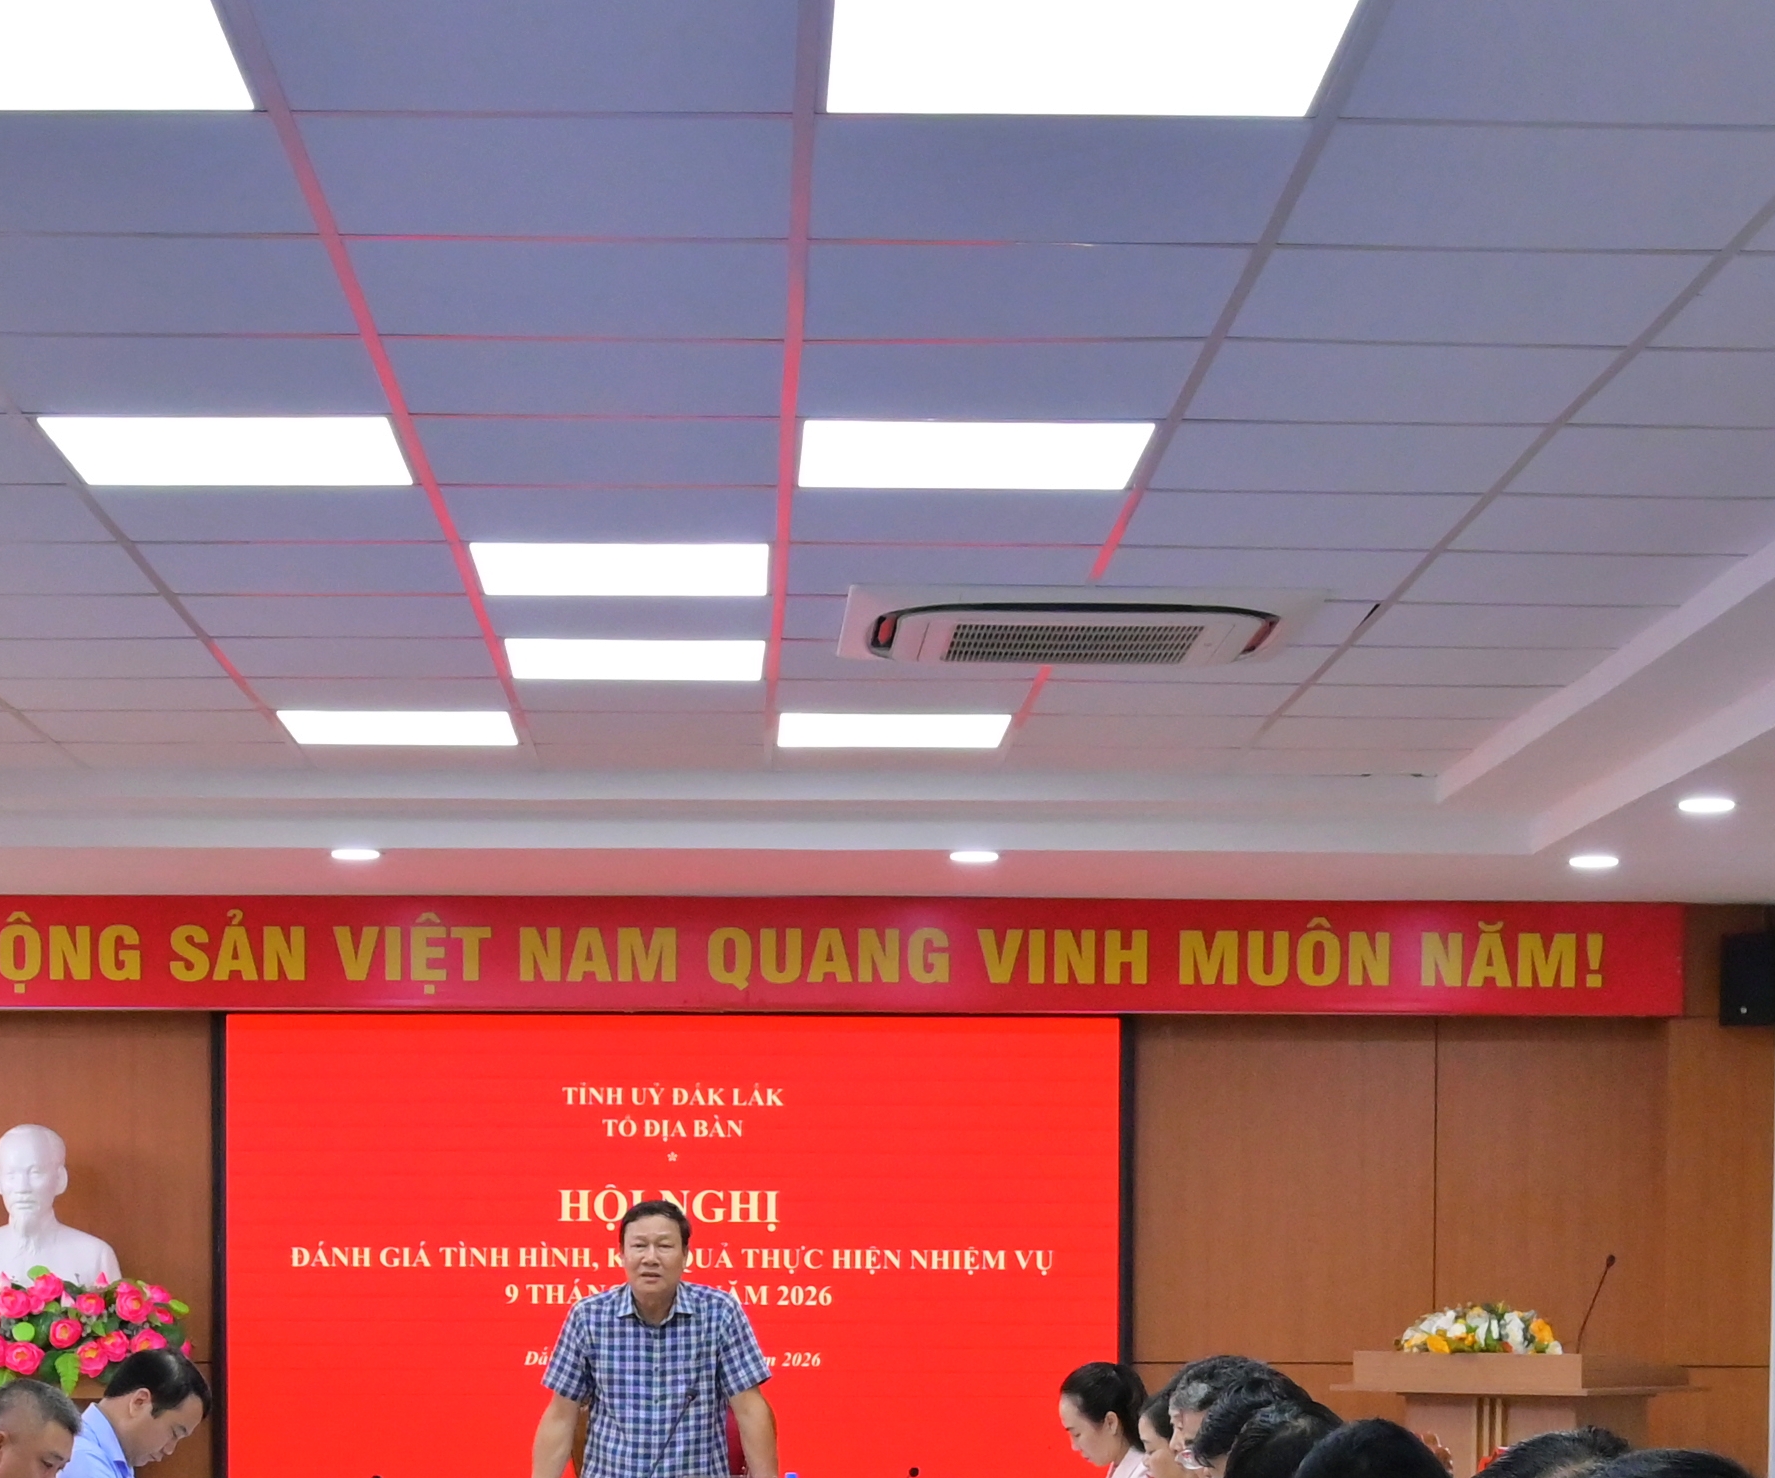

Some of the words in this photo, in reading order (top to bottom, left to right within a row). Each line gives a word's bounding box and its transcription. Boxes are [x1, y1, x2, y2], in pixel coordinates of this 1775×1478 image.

[169, 909, 306, 982] SẢN
[332, 911, 492, 995] VIỆT
[519, 926, 678, 983] NAM
[707, 927, 951, 991] QUANG
[977, 928, 1148, 985] VINH
[1179, 916, 1391, 987] MUÔN
[1421, 920, 1605, 989] NĂM!
[562, 1082, 624, 1105] TỈNH
[631, 1082, 664, 1105] UỶ
[672, 1083, 725, 1106] ĐẮK
[732, 1083, 784, 1106] LẮK
[602, 1115, 637, 1138] TỔ
[643, 1119, 687, 1142] ĐỊA
[693, 1115, 743, 1138] BÀN
[291, 1241, 371, 1268] ĐÁNH
[379, 1241, 431, 1268] GIÁ
[439, 1241, 509, 1268] TÌNH
[519, 1241, 599, 1272] HÌNH,
[741, 1245, 823, 1275] THỰC
[832, 1246, 901, 1276] HIỆN
[910, 1246, 1007, 1276] NHIỆM
[1014, 1249, 1054, 1276] VỤ
[505, 1284, 520, 1304] 9
[717, 1280, 770, 1306] ĂM
[777, 1286, 832, 1306] 2026
[781, 1351, 821, 1367] 2026
